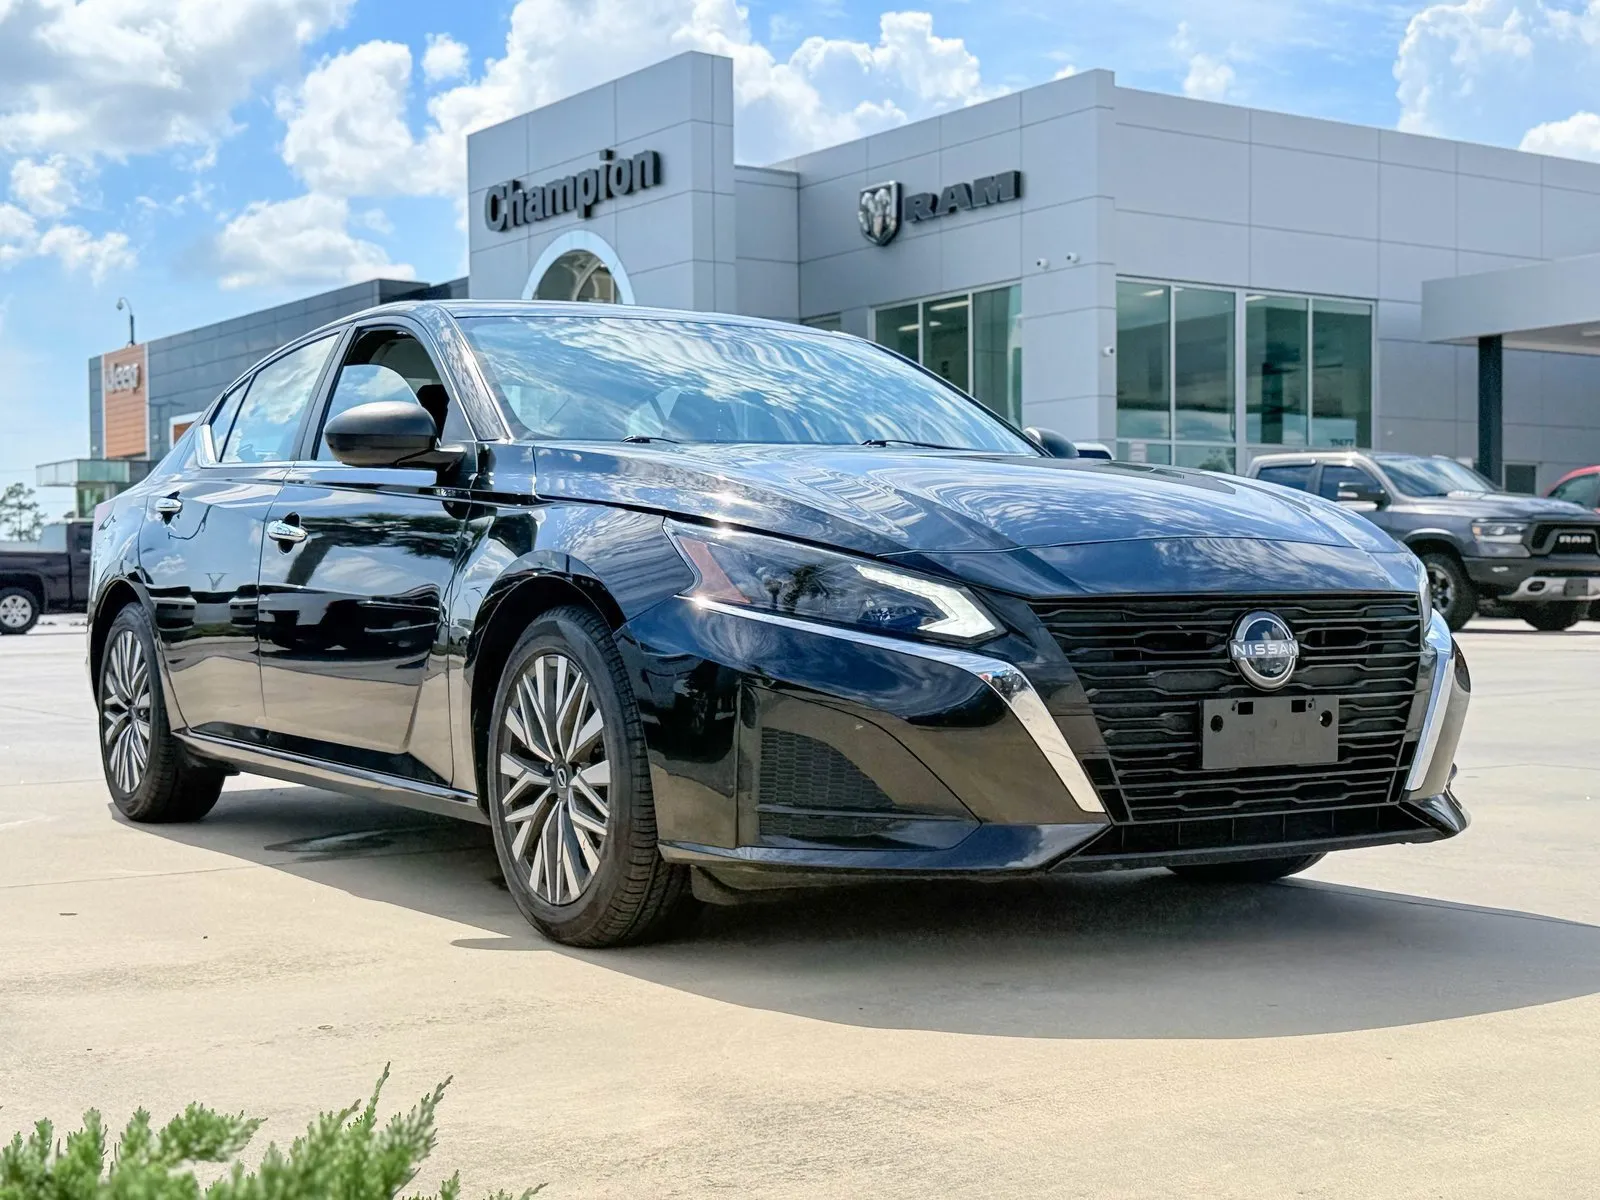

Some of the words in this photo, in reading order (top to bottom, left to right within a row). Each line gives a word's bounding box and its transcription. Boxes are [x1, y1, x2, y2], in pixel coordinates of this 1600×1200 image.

[485, 149, 660, 231] Champion
[904, 171, 1020, 222] RAM
[1559, 535, 1592, 544] RAM
[1233, 643, 1299, 656] NISSAN
